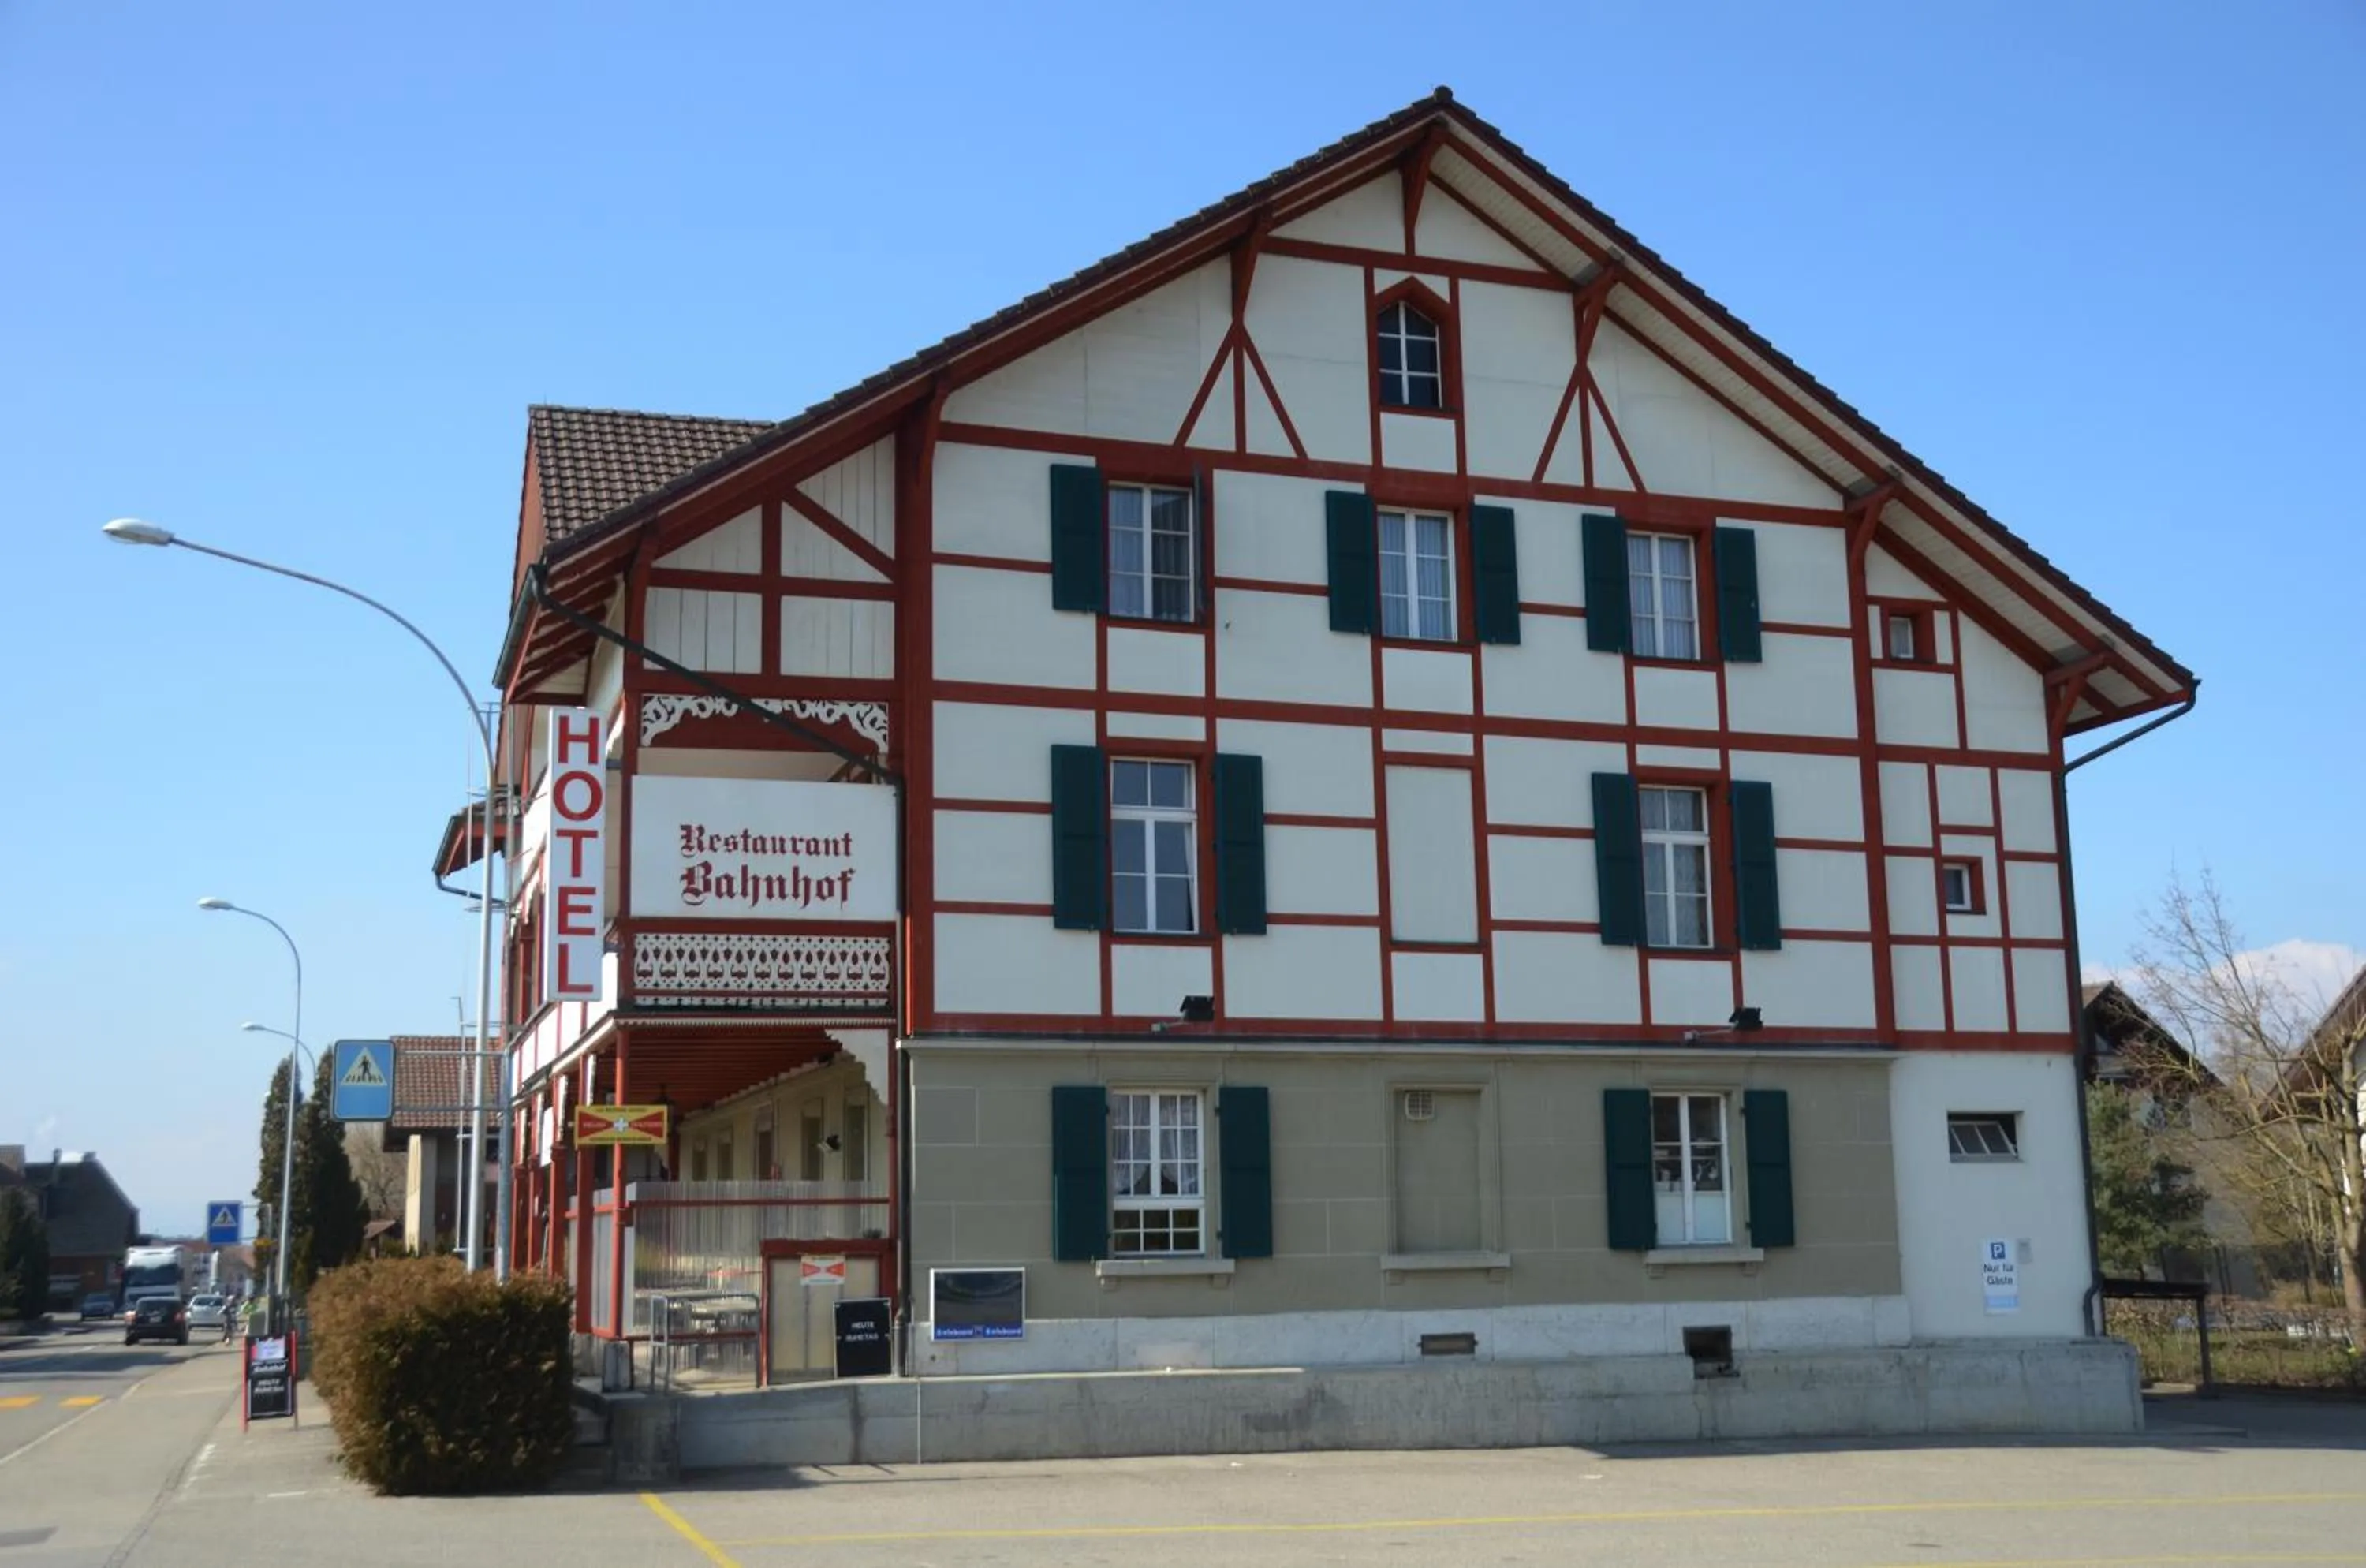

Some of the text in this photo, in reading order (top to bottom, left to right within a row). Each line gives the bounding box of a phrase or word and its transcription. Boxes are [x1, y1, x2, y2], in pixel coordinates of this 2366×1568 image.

[553, 715, 603, 993] HOTEL
[679, 824, 853, 857] Restaurant
[680, 861, 856, 909] Bahnhof
[1983, 1264, 1999, 1273] Nur
